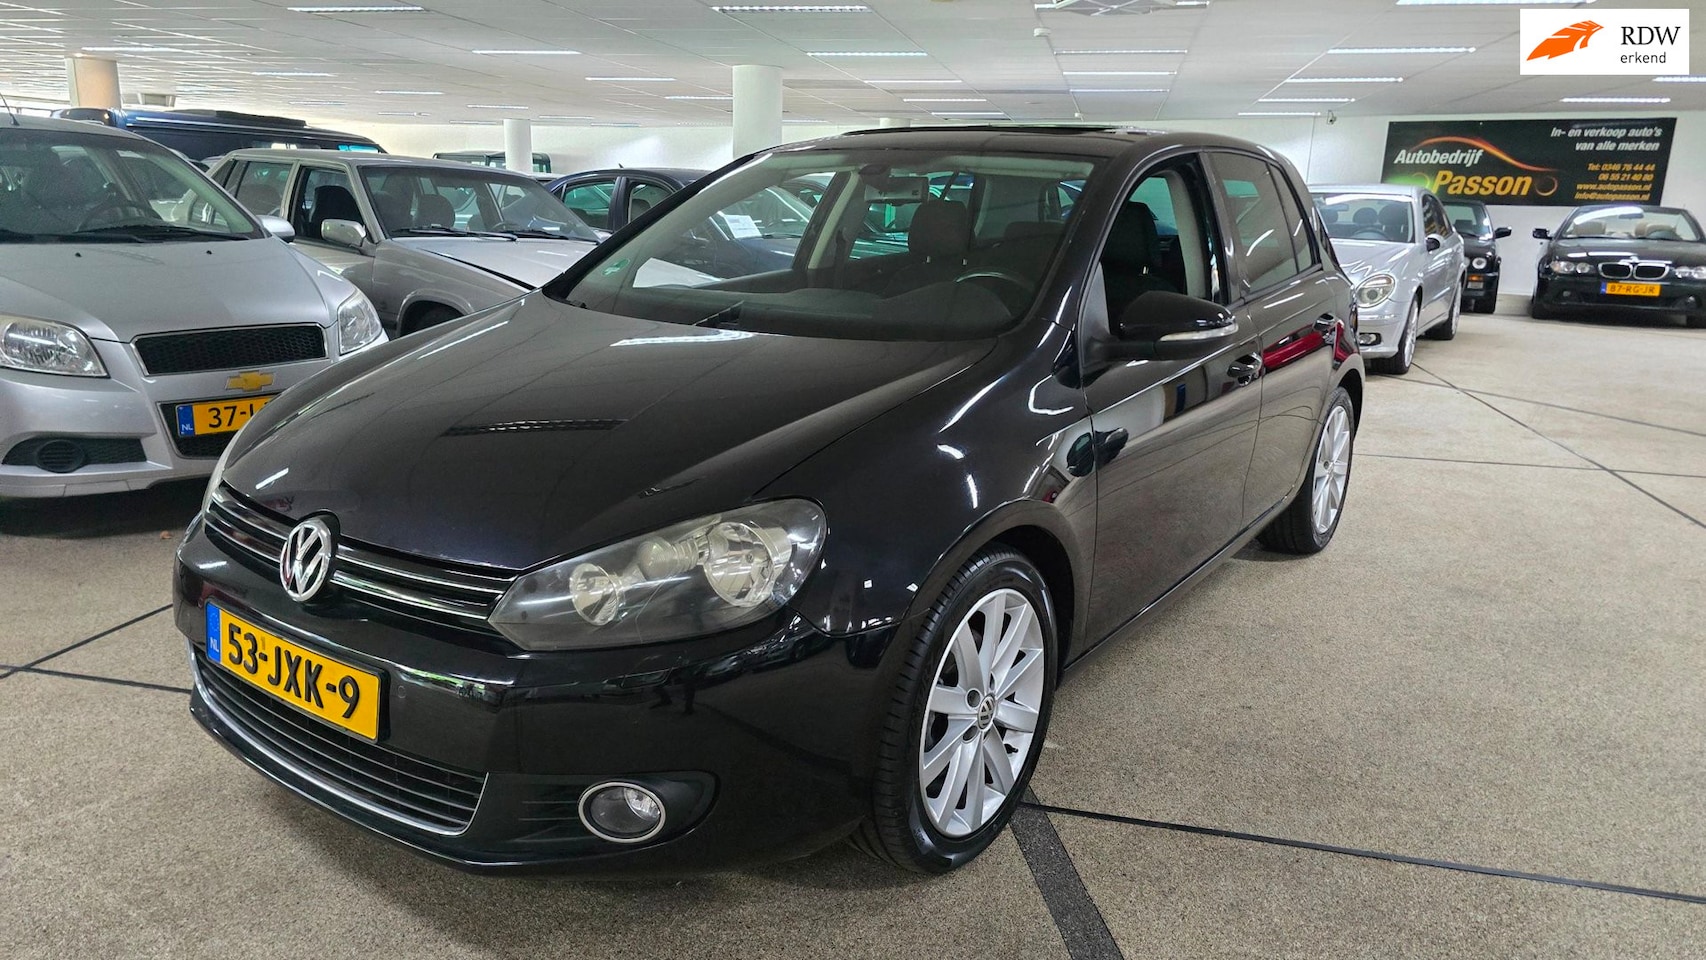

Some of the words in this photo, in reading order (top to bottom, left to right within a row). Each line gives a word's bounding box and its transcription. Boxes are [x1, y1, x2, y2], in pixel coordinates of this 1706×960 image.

[1550, 127, 1566, 138] In-
[1567, 128, 1582, 138] en
[1583, 127, 1627, 139] verkoop
[1627, 127, 1663, 138] auto's
[1575, 142, 1595, 151] van
[1595, 141, 1617, 151] alle
[1616, 141, 1661, 151] merken
[1393, 149, 1485, 168] Autobedrijf
[1430, 170, 1533, 197] Passon
[1620, 173, 1632, 181] 21
[1609, 284, 1656, 294] 87-RG-JR
[181, 423, 194, 432] NL
[207, 400, 271, 430] 37-
[209, 636, 219, 653] NL
[228, 622, 361, 720] 53-JXK-9
